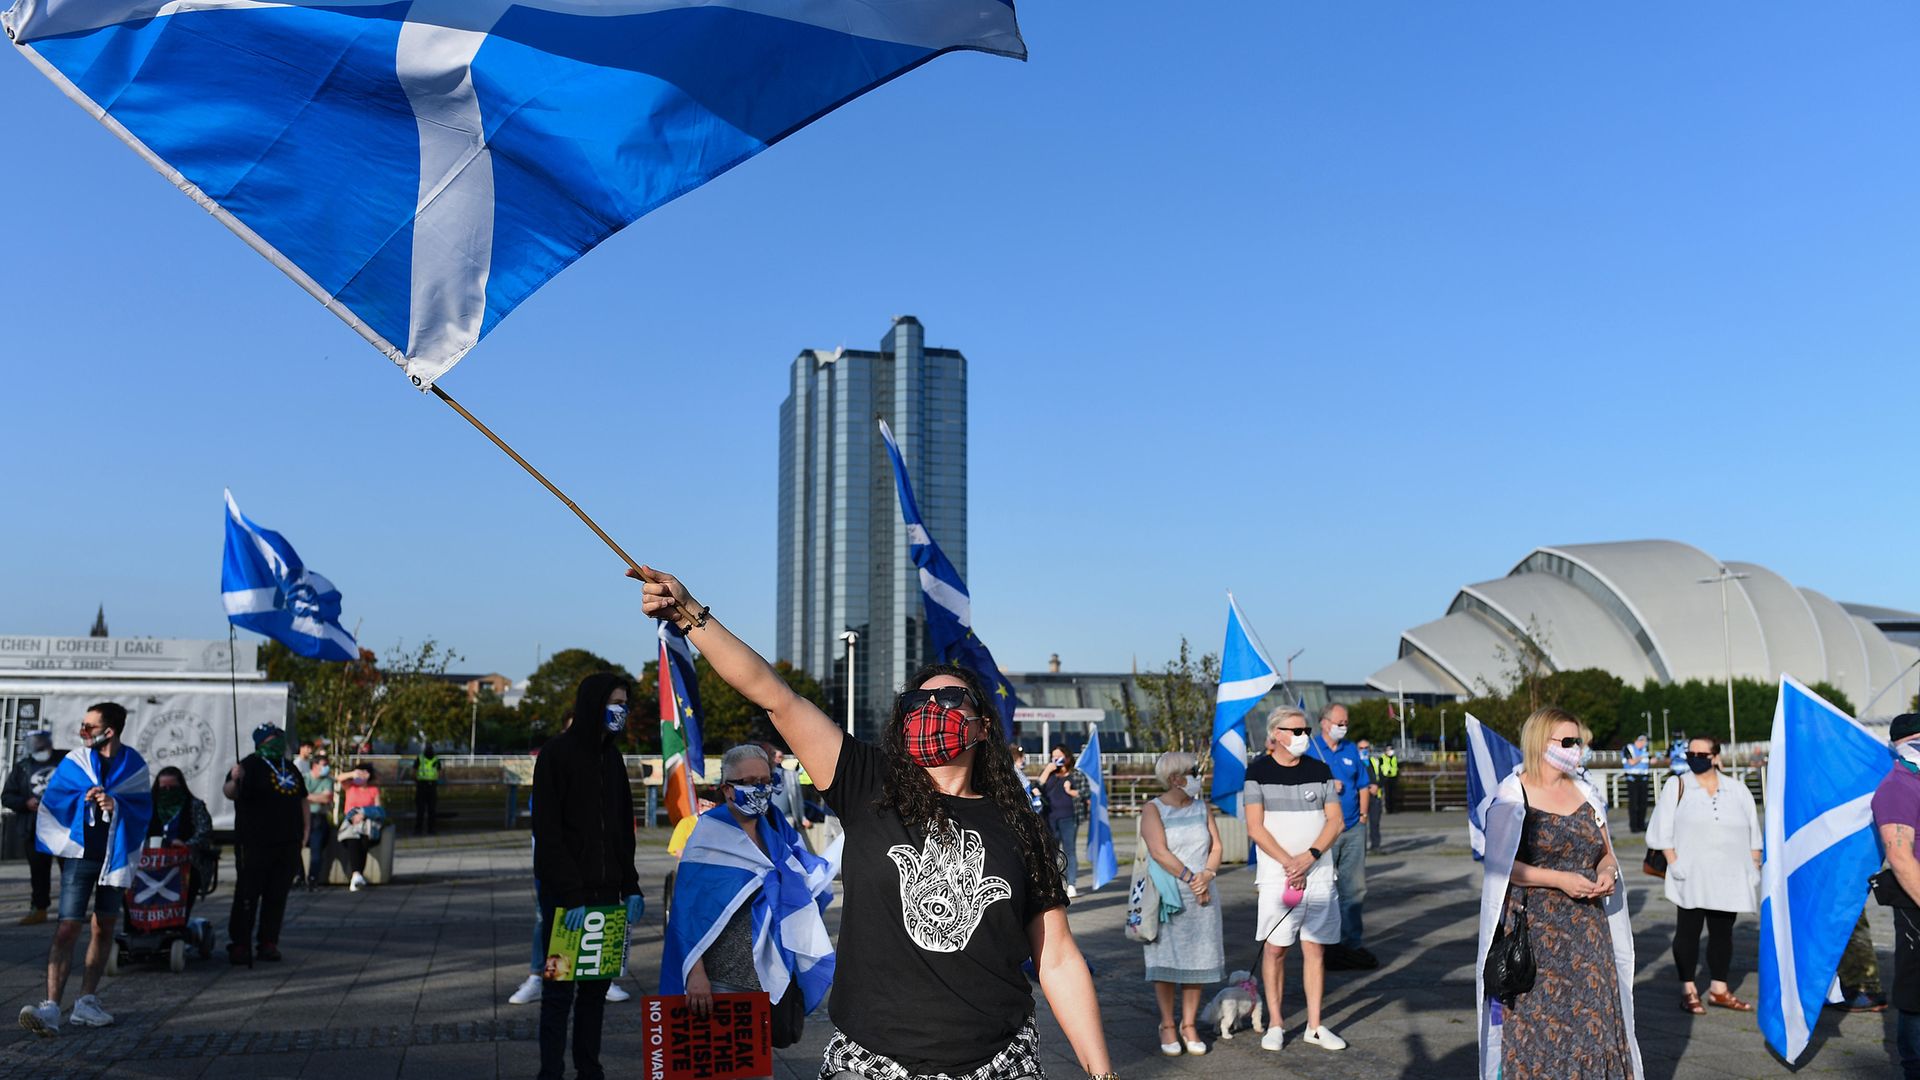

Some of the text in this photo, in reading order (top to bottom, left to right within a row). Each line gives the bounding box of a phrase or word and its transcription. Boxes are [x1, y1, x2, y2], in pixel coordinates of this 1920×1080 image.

[0, 639, 163, 654] CHEN COFFEE CAKE
[156, 744, 200, 760] Cabin
[575, 911, 606, 976] OUT!
[600, 913, 617, 975] TORIES
[613, 909, 626, 941] KICK
[610, 948, 623, 973] THE
[649, 1001, 664, 1080] NO TO WAR
[671, 1007, 691, 1071] STATE
[692, 1012, 712, 1078] RITISH
[713, 1000, 734, 1073] UP THE
[734, 1001, 754, 1069] BREAK
